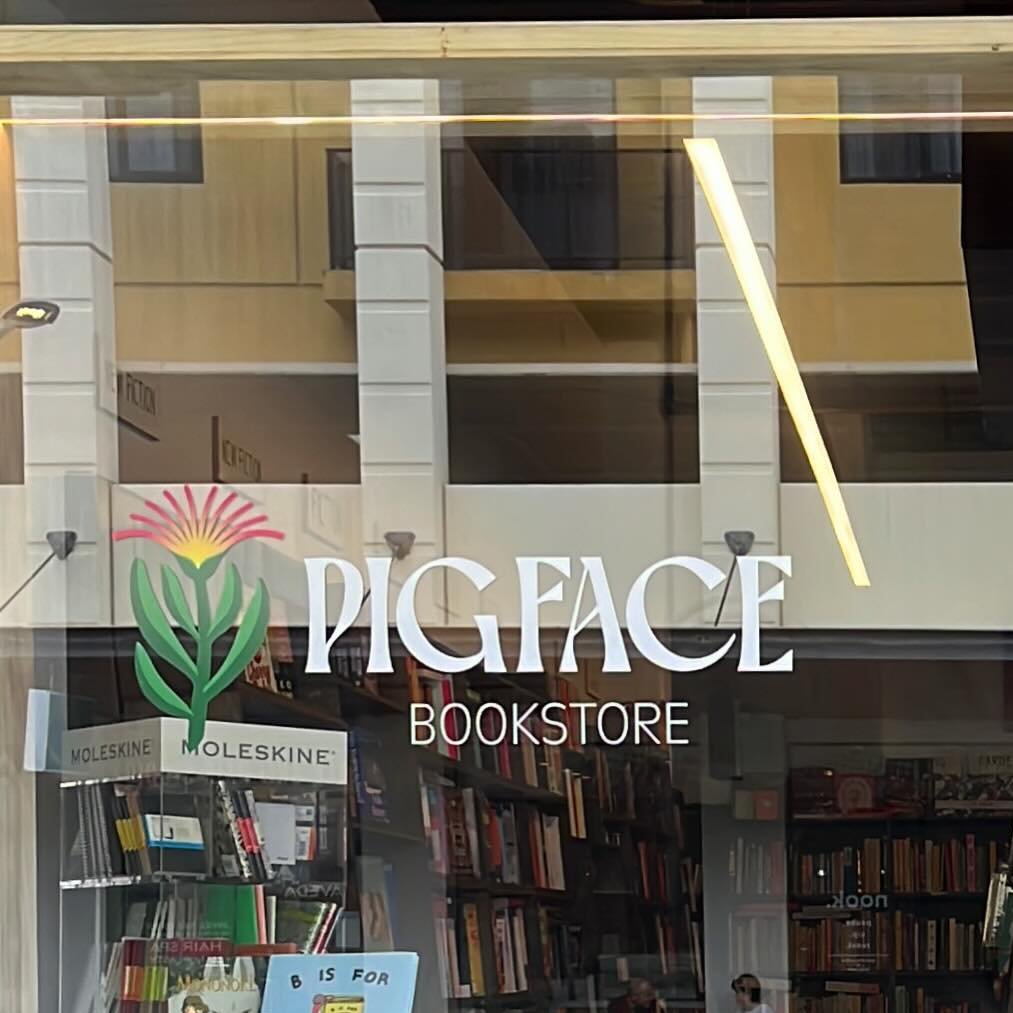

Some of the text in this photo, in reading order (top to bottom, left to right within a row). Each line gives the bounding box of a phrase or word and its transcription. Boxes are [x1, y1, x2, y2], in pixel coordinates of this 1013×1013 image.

[303, 555, 794, 674] PIGFACE
[410, 702, 690, 747] BOOKSTORE
[71, 739, 152, 764] MOLESKINE
[291, 967, 389, 989] B IS FOR
